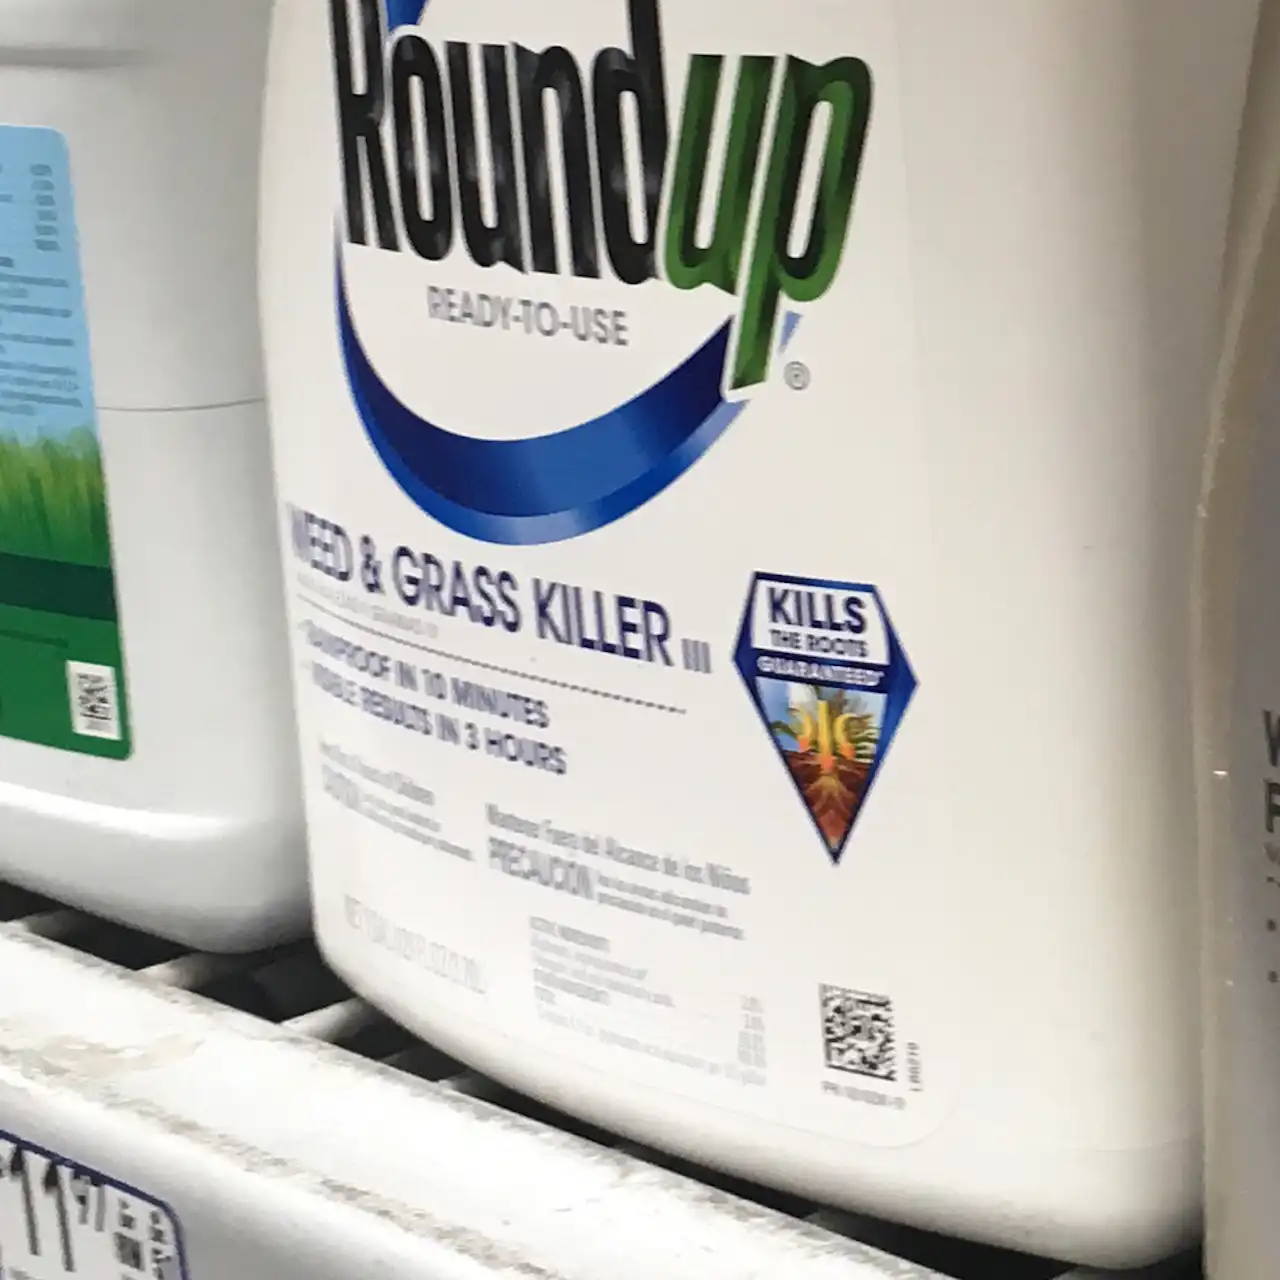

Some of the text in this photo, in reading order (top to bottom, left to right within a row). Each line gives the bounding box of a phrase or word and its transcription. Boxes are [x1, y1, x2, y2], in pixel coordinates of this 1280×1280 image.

[427, 286, 628, 347] READY-TO-USE
[360, 534, 385, 594] &
[393, 545, 520, 633] GRASS
[533, 578, 673, 666] KILLER
[768, 587, 868, 634] KILLS
[769, 629, 868, 658] THE ROOTS
[394, 660, 418, 692] IN
[450, 677, 551, 729] MINUTES
[436, 713, 460, 745] IN
[464, 722, 479, 750] 3
[484, 727, 567, 775] HOURS
